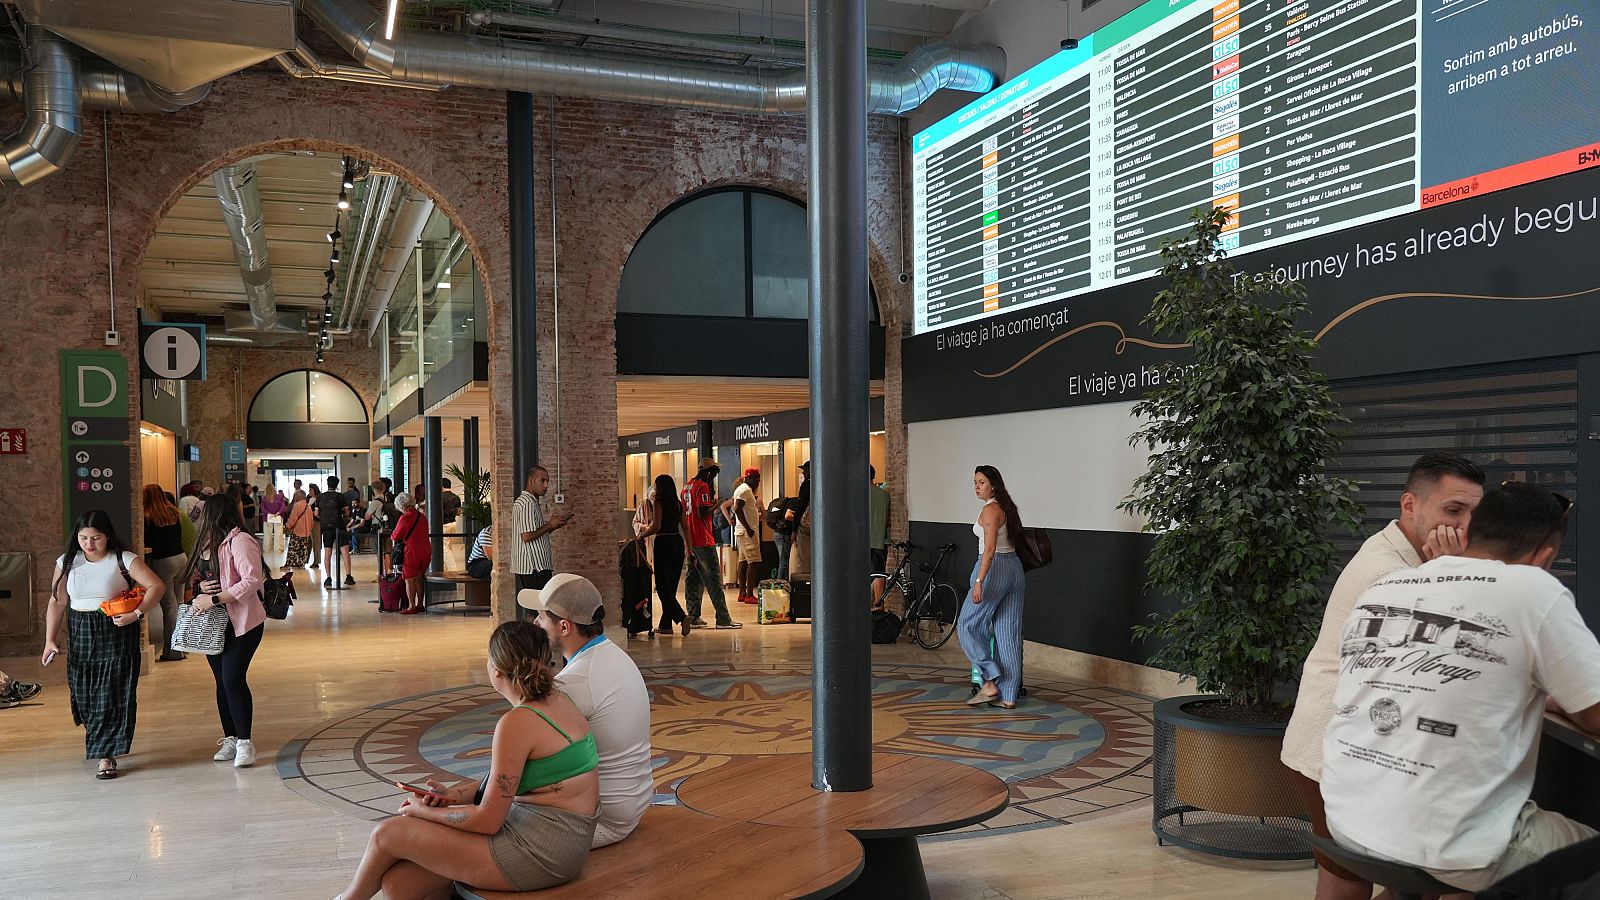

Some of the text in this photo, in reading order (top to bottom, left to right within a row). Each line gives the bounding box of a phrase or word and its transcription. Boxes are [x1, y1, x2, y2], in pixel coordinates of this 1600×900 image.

[1265, 24, 1272, 32] 35
[1287, 28, 1300, 39] Paris
[1336, 7, 1346, 16] Bus
[1215, 38, 1238, 59] alsa
[1287, 45, 1310, 61] Zaragoza
[1444, 14, 1582, 73] Sortim amb autobús,
[1098, 66, 1111, 78] 11:00
[1287, 72, 1304, 84] Girona
[1308, 60, 1332, 77] Aeroport
[1448, 42, 1577, 94] arribem a tot arreu.
[1098, 83, 1111, 94] 11:15
[1215, 78, 1238, 98] alsa
[1264, 86, 1272, 94] 24
[1286, 94, 1303, 105] Servei
[1322, 83, 1328, 91] de
[1338, 75, 1351, 85] Roca
[1264, 106, 1271, 114] 29
[1310, 108, 1320, 117] Mar
[1351, 93, 1363, 102] Mar
[1323, 146, 1336, 156] Roca
[1215, 157, 1238, 175] alsa
[1339, 164, 1350, 172] Bus
[1351, 182, 1362, 191] Mar
[1423, 184, 1470, 204] Barcelona
[1268, 253, 1349, 290] journey
[1356, 243, 1396, 268] has
[1404, 214, 1504, 257] already
[1515, 198, 1600, 235] begu
[936, 307, 1069, 350] El viatge ja ha començat
[78, 366, 117, 407] D
[1070, 376, 1081, 395] El
[1084, 372, 1116, 394] viaje
[1119, 370, 1136, 394] ya
[1142, 366, 1160, 386] ha
[736, 418, 768, 440] moventis
[230, 446, 240, 460] E
[1371, 576, 1496, 588] ALIFORNIA DREAMS
